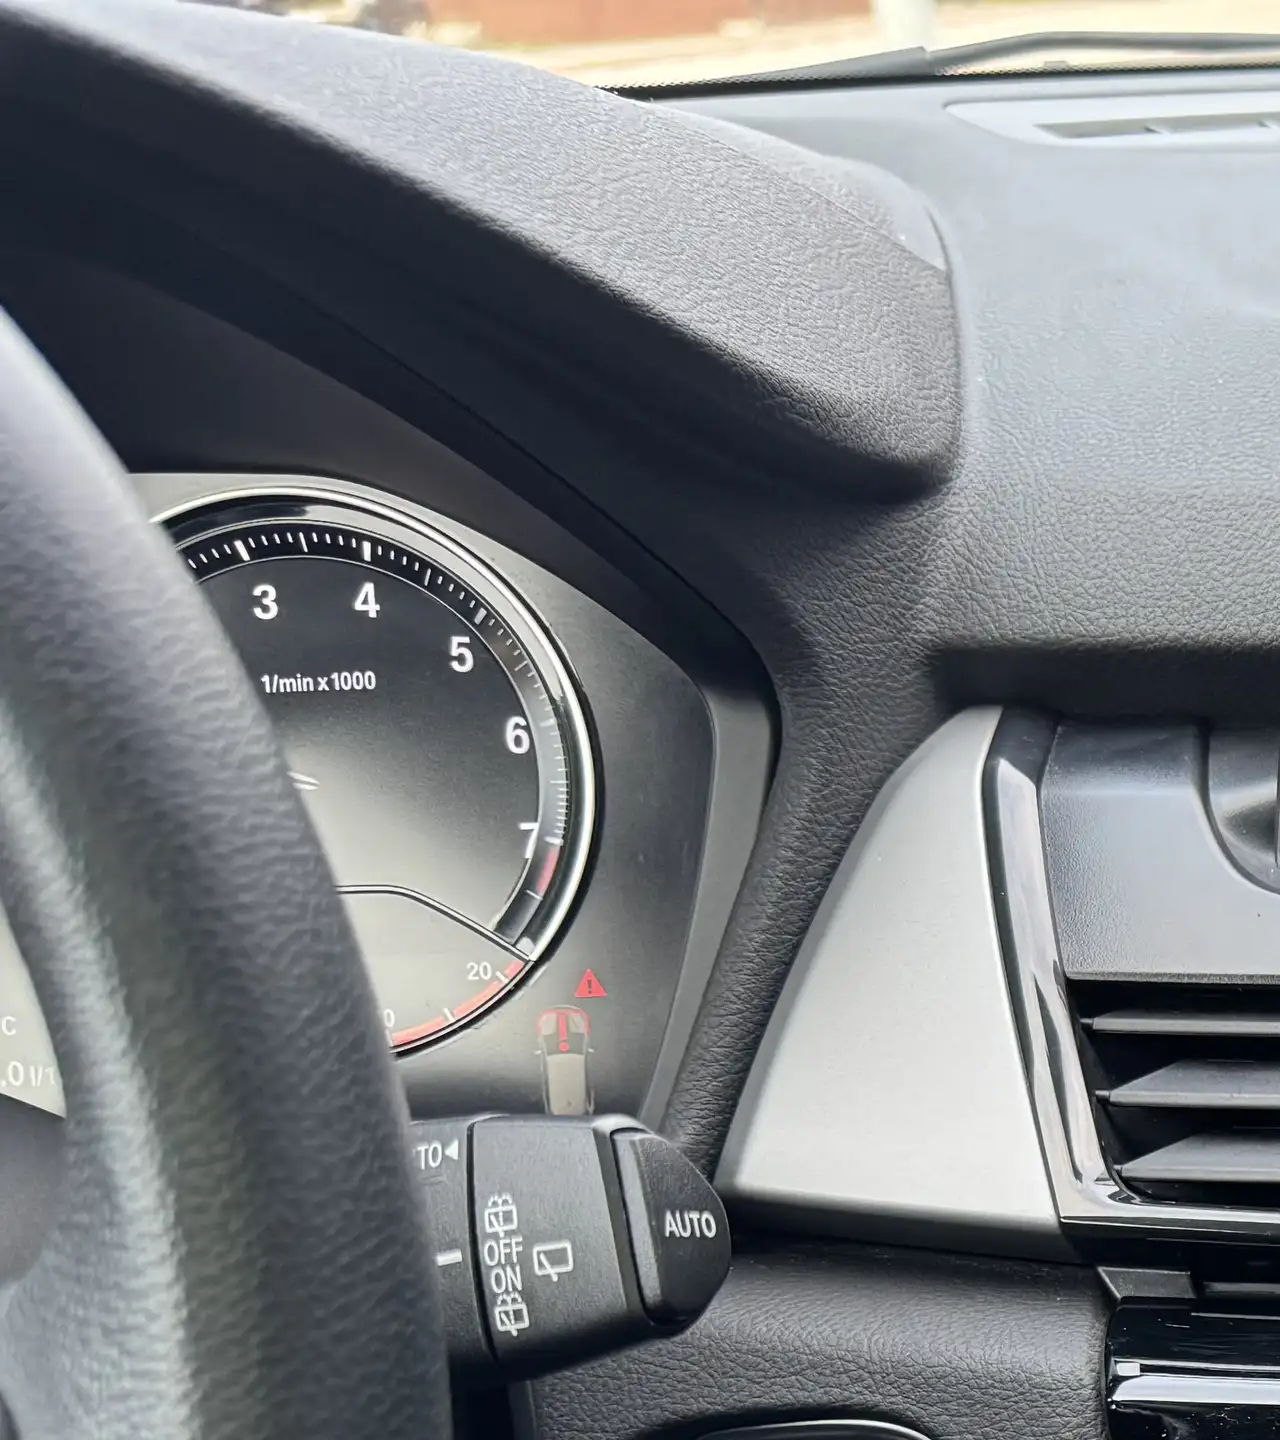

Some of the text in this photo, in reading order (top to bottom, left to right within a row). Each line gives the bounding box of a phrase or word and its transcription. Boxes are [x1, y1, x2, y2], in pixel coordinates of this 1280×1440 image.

[252, 584, 279, 620] 3
[354, 582, 381, 618] 4
[450, 636, 474, 673] 5
[505, 716, 530, 754] 6
[466, 961, 492, 981] 20
[664, 1209, 718, 1239] AUTO
[483, 1236, 524, 1267] OFF
[490, 1264, 523, 1295] ON
